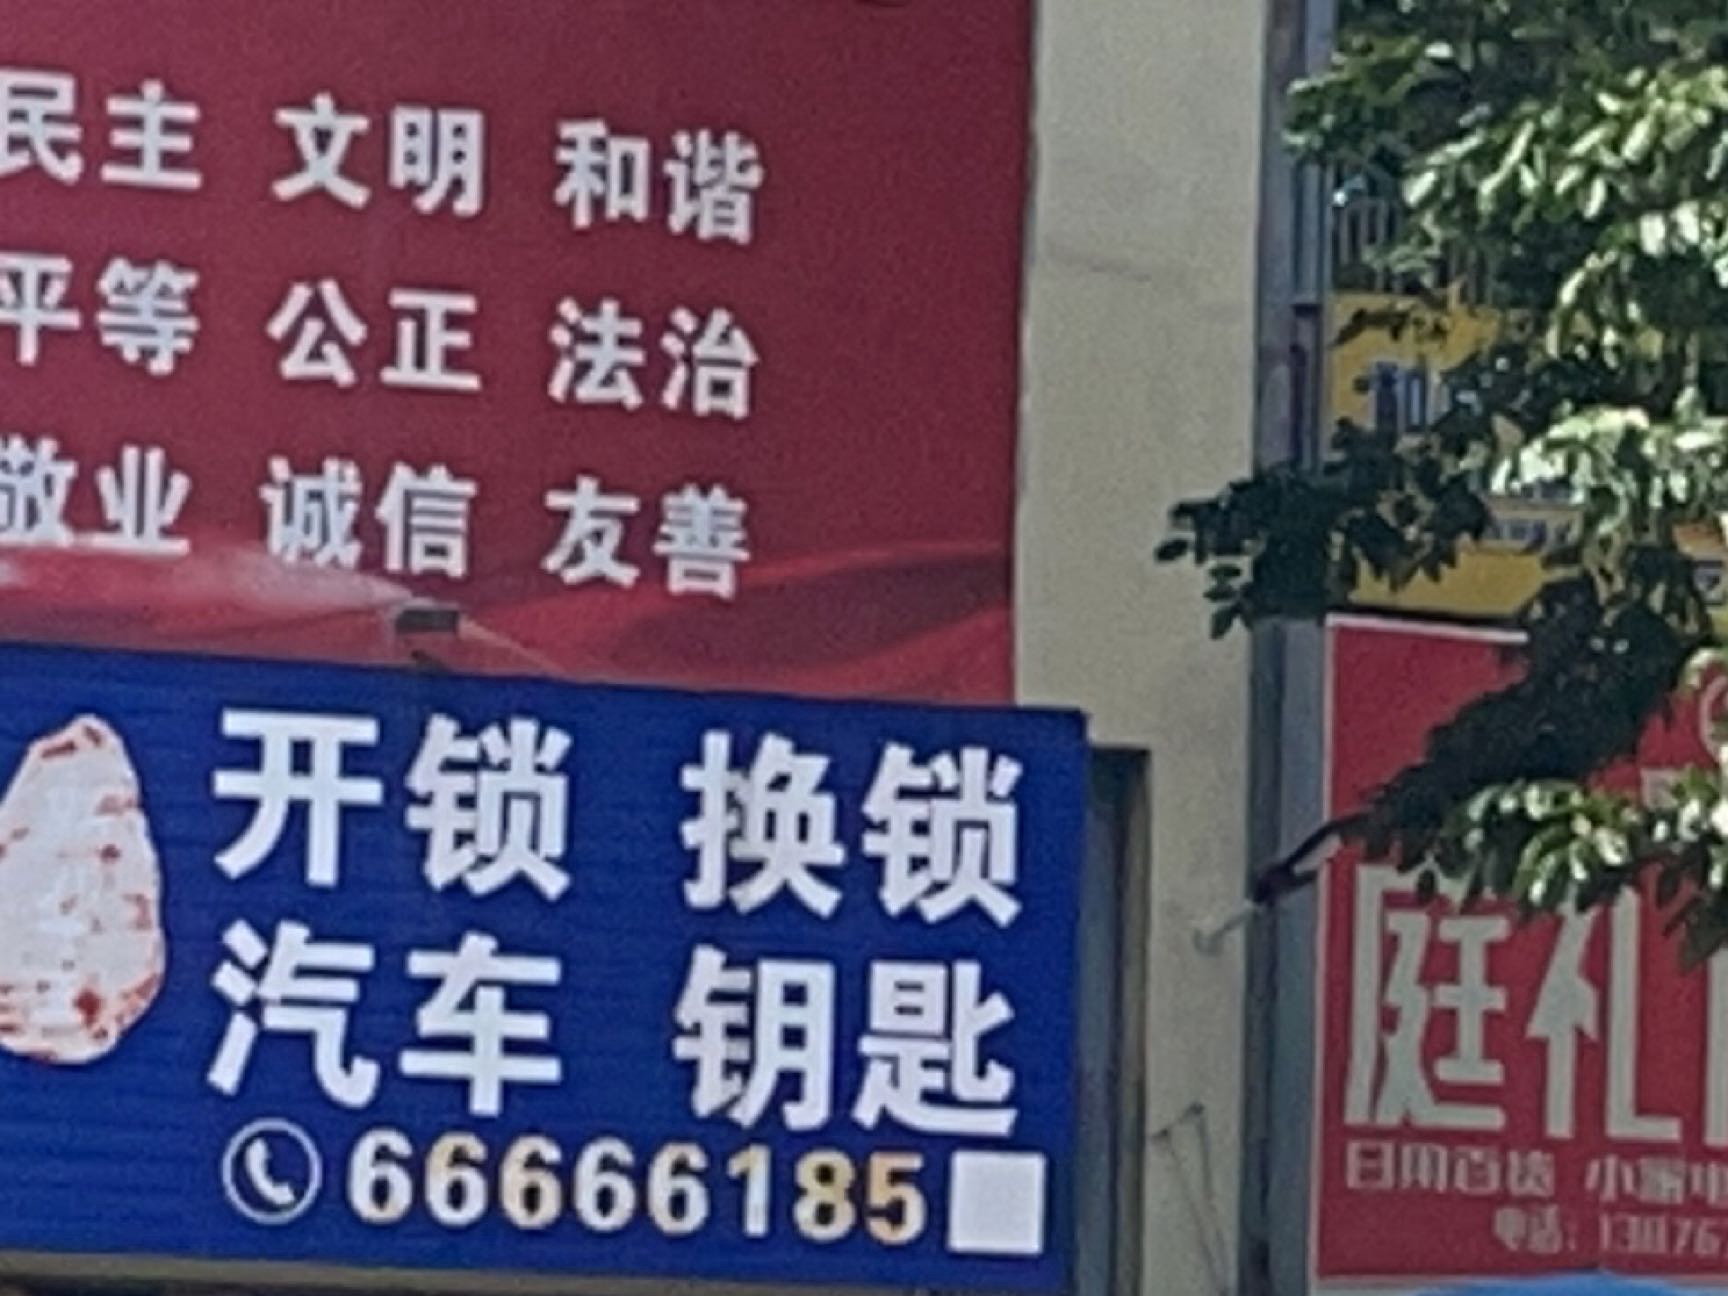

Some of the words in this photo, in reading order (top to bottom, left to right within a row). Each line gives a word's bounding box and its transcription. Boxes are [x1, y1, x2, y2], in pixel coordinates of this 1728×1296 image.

[0, 69, 201, 190] 民主
[272, 92, 485, 215] 文明
[554, 119, 763, 244] 和谐
[0, 252, 199, 375] 平等
[266, 279, 482, 390] 公正
[547, 297, 758, 419] 法治
[0, 434, 191, 557] 敬业
[259, 456, 477, 578] 诚信
[542, 475, 751, 599] 友善
[213, 708, 572, 900] 开锁
[680, 730, 1022, 927] 换锁
[208, 919, 562, 1116] 汽车
[674, 945, 1018, 1136] 钥匙
[348, 1127, 926, 1244] 66666185
